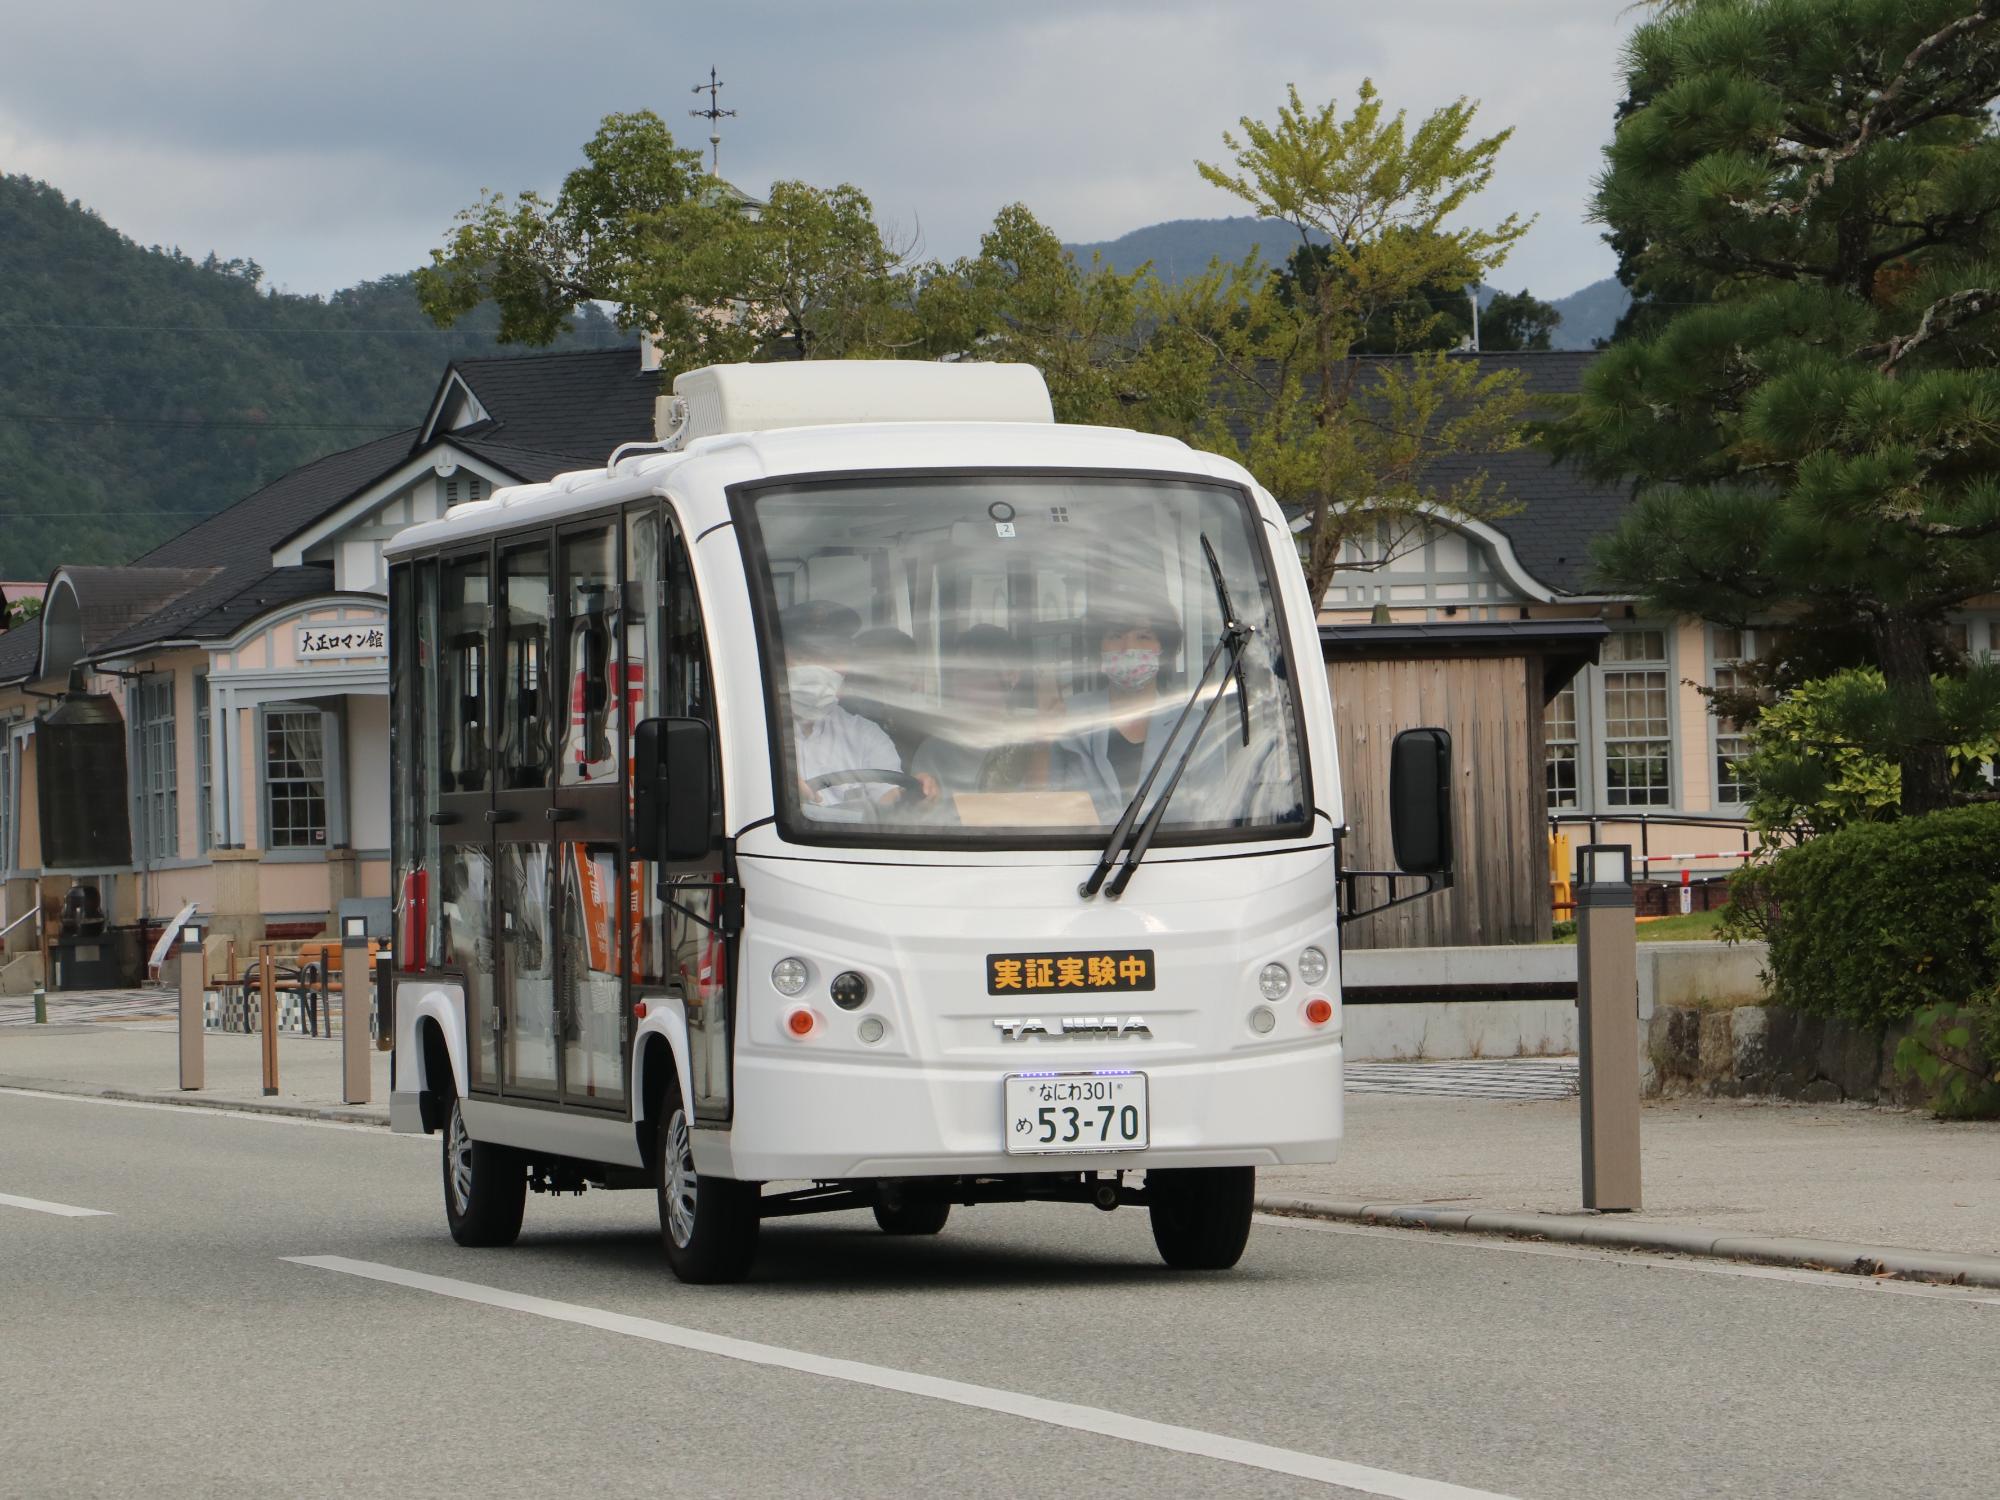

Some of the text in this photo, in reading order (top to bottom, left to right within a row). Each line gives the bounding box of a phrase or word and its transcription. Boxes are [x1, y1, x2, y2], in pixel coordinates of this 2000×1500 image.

[302, 629, 384, 652] 大正ロマン館
[994, 955, 1146, 989] 実証実験中
[993, 1015, 1153, 1041] TAJIMA
[1039, 1081, 1113, 1101] なにわ301
[1015, 1105, 1139, 1143] め 53-70
